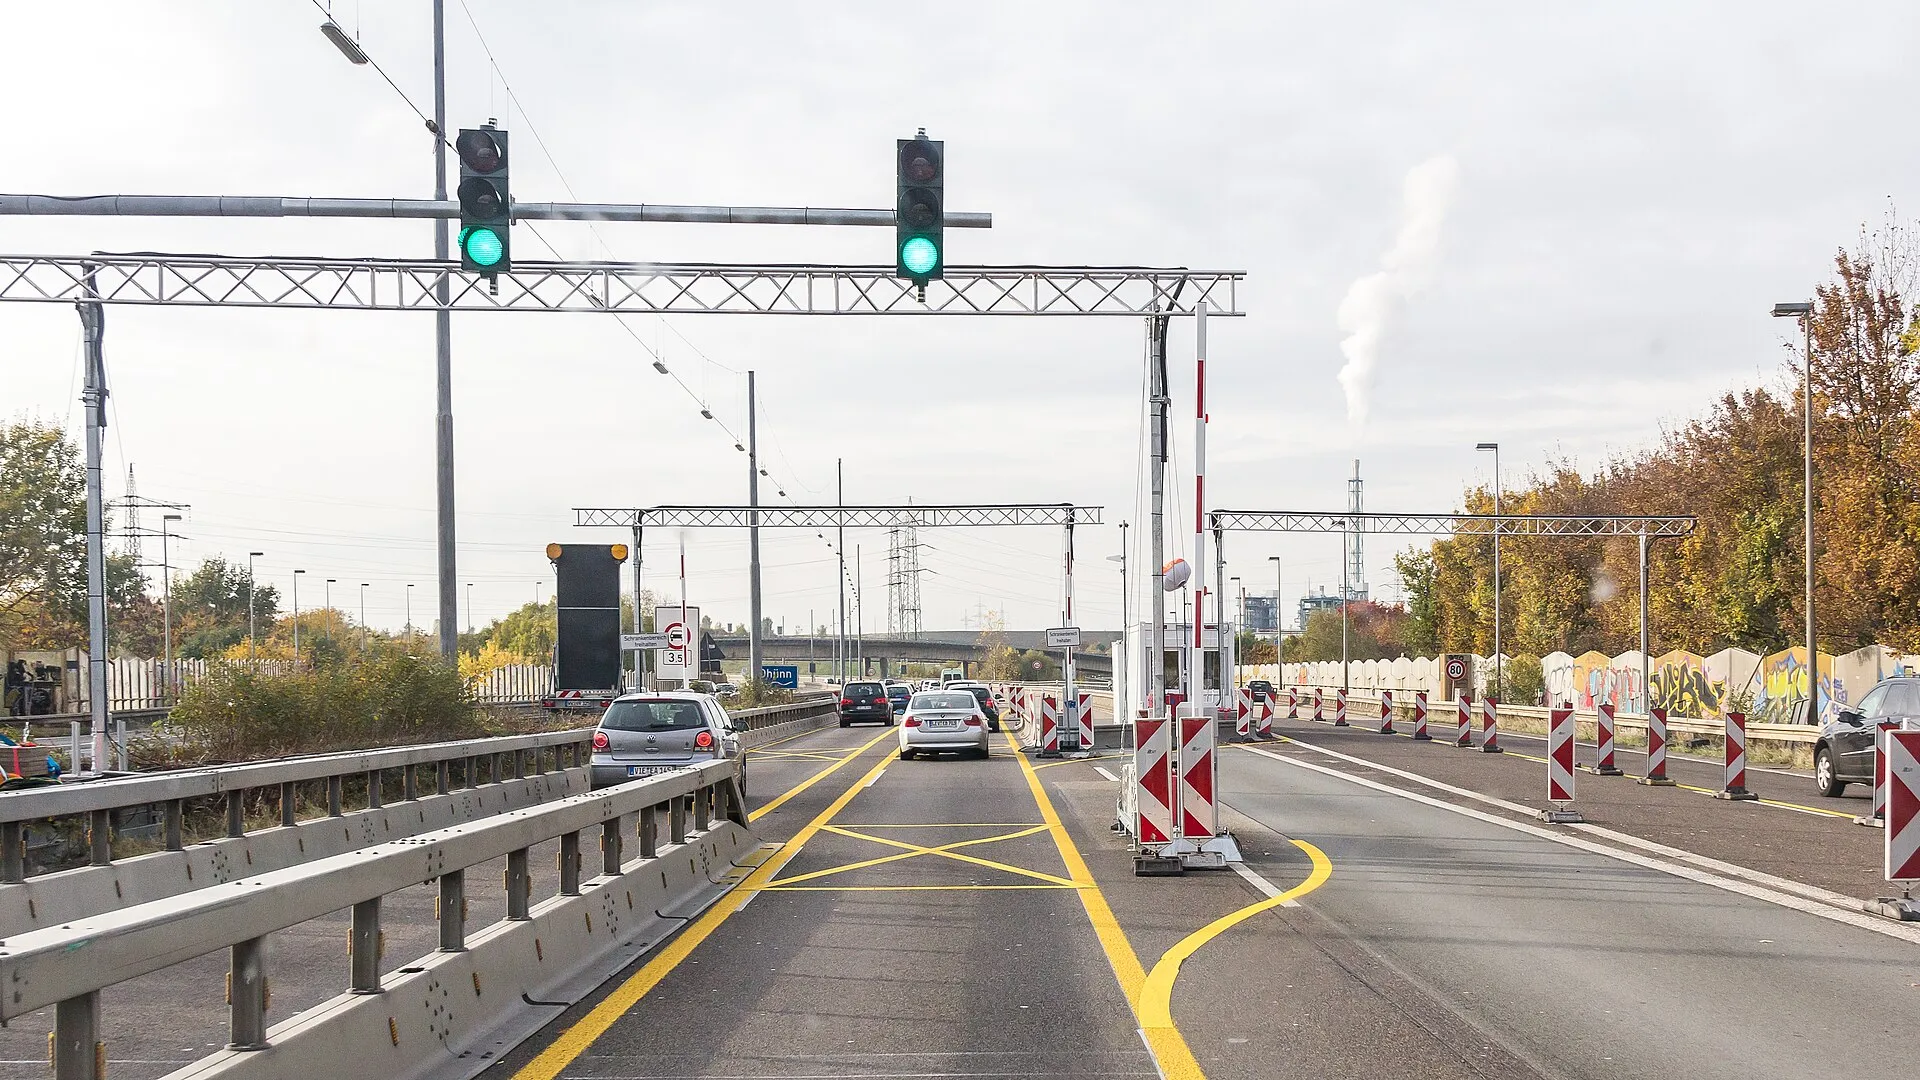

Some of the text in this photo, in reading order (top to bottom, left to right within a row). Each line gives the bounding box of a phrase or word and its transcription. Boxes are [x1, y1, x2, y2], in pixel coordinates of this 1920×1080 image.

[624, 634, 668, 642] Schrankenbereich
[1450, 665, 1462, 675] 80
[634, 767, 646, 775] VIE
